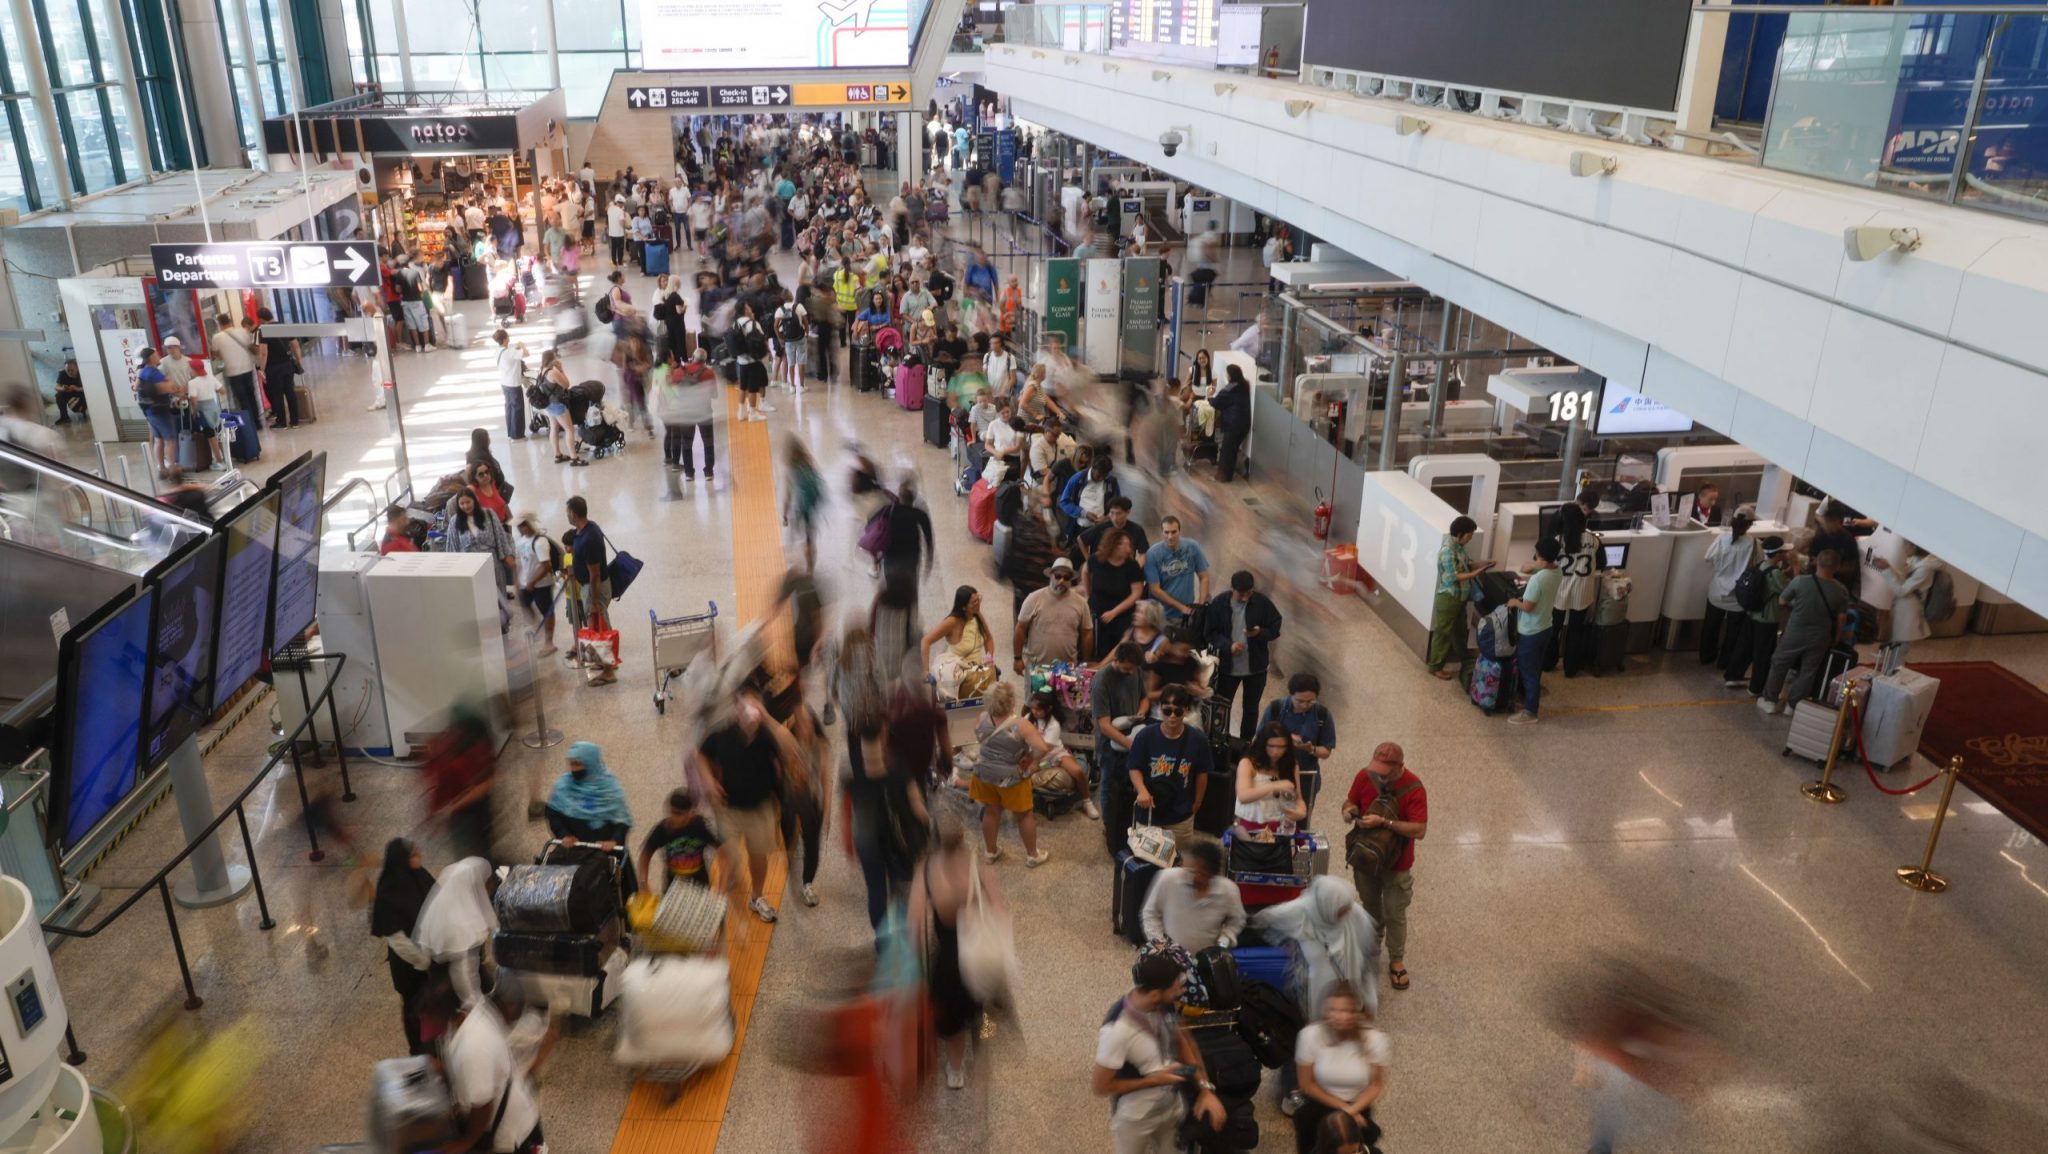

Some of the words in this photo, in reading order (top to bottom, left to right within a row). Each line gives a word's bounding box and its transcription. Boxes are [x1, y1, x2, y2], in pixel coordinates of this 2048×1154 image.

[671, 89, 700, 98] Check-in
[719, 88, 748, 97] Check-in
[1893, 130, 1960, 154] ADR
[162, 268, 240, 284] Departures
[252, 256, 282, 276] T3
[1549, 391, 1593, 422] 181
[1378, 503, 1418, 592] T3
[1557, 554, 1592, 577] 23
